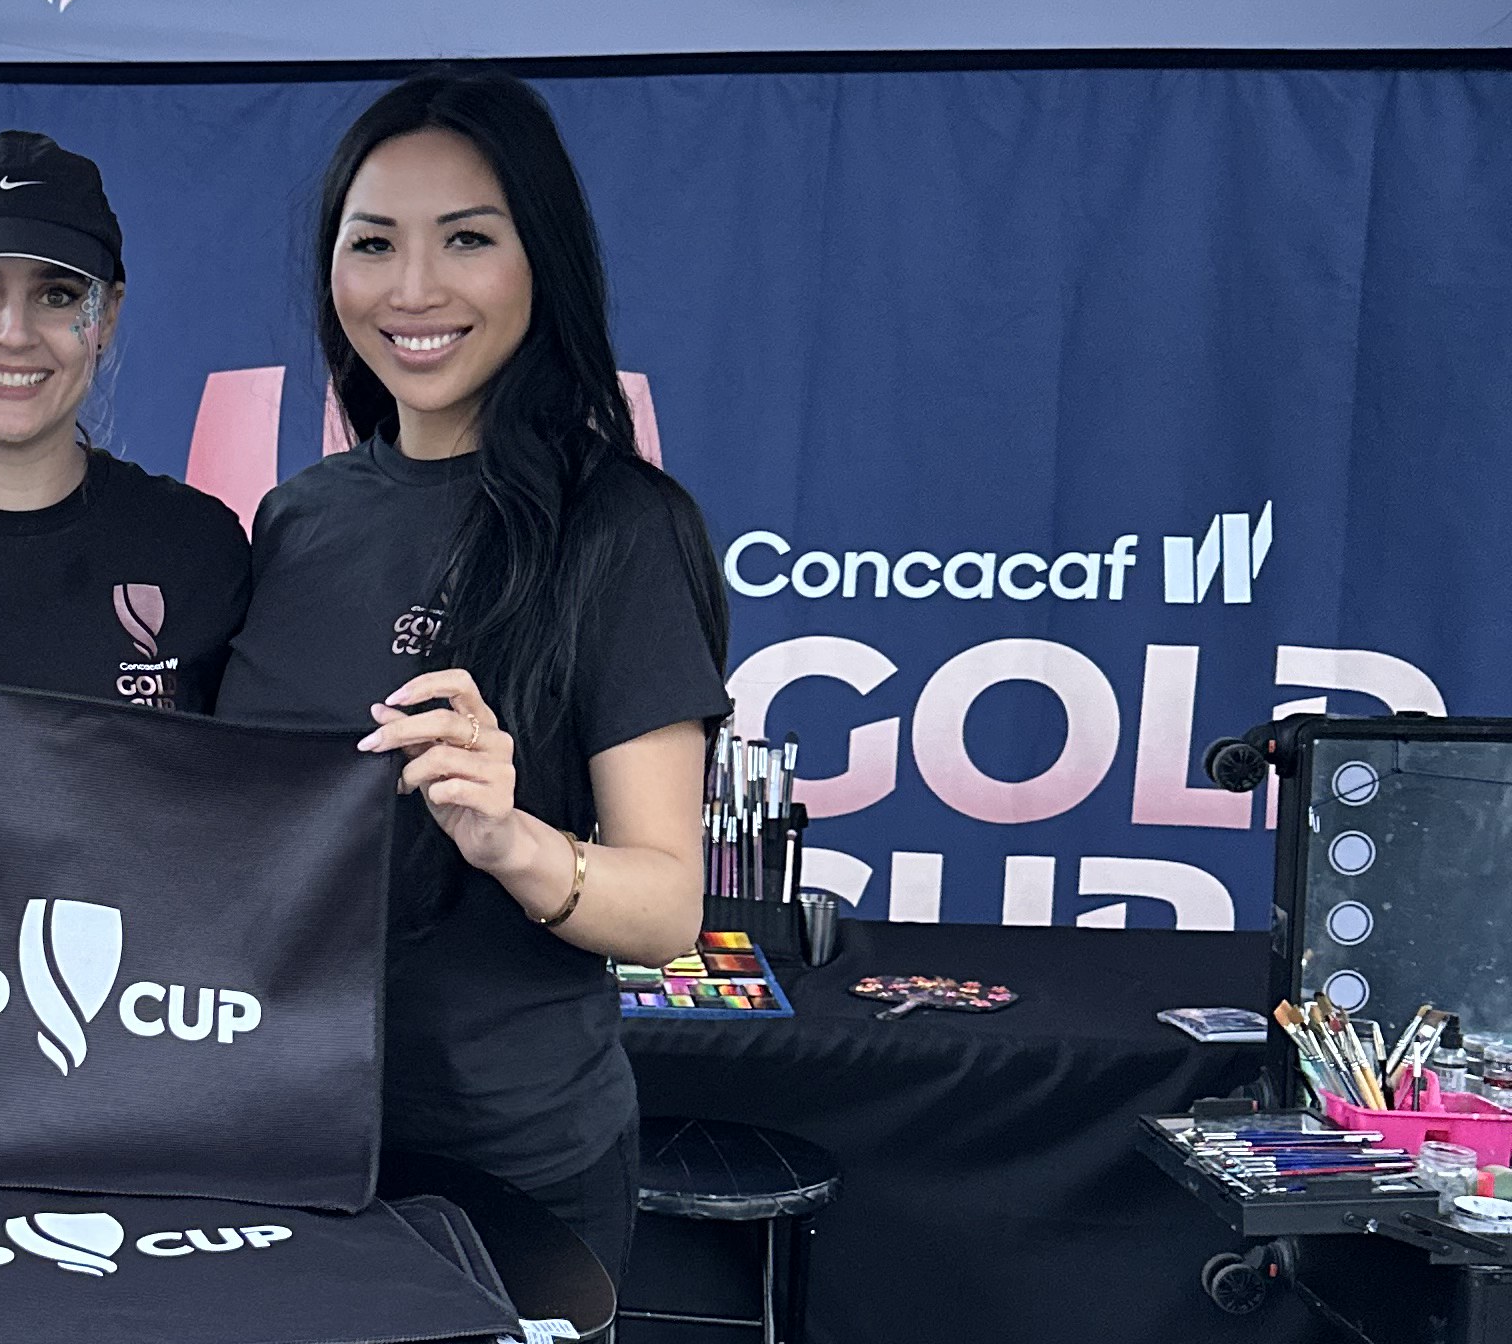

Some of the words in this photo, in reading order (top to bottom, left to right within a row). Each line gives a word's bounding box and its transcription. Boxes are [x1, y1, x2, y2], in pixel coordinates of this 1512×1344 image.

[724, 529, 1138, 603] Concacaf
[119, 981, 262, 1044] CUP
[136, 1224, 293, 1257] CUP
